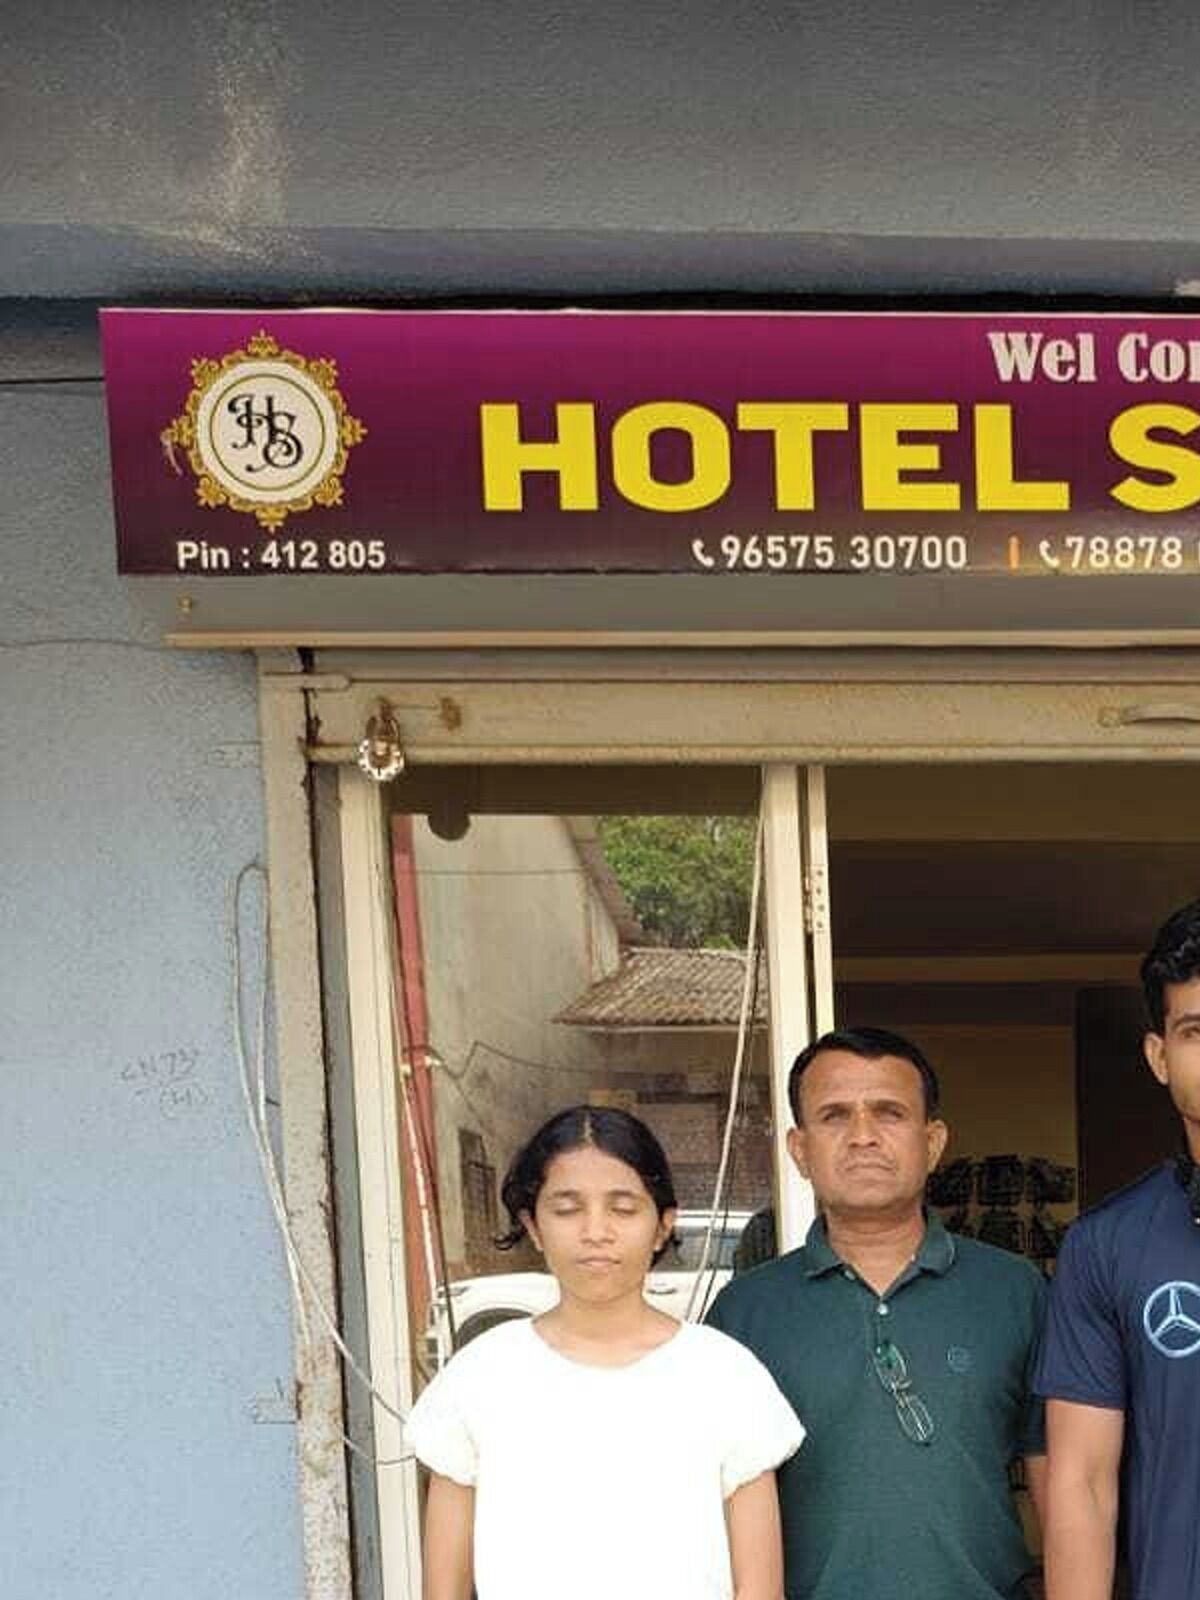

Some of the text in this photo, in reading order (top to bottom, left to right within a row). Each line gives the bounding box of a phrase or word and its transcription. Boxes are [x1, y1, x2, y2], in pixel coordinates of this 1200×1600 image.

[988, 332, 1096, 382] Wel
[480, 401, 1071, 513] HOTEL
[177, 540, 230, 568] Pin
[261, 540, 319, 568] 412
[329, 540, 386, 568] 805
[720, 536, 968, 570] 96575 30700
[1066, 536, 1182, 569] 78878
